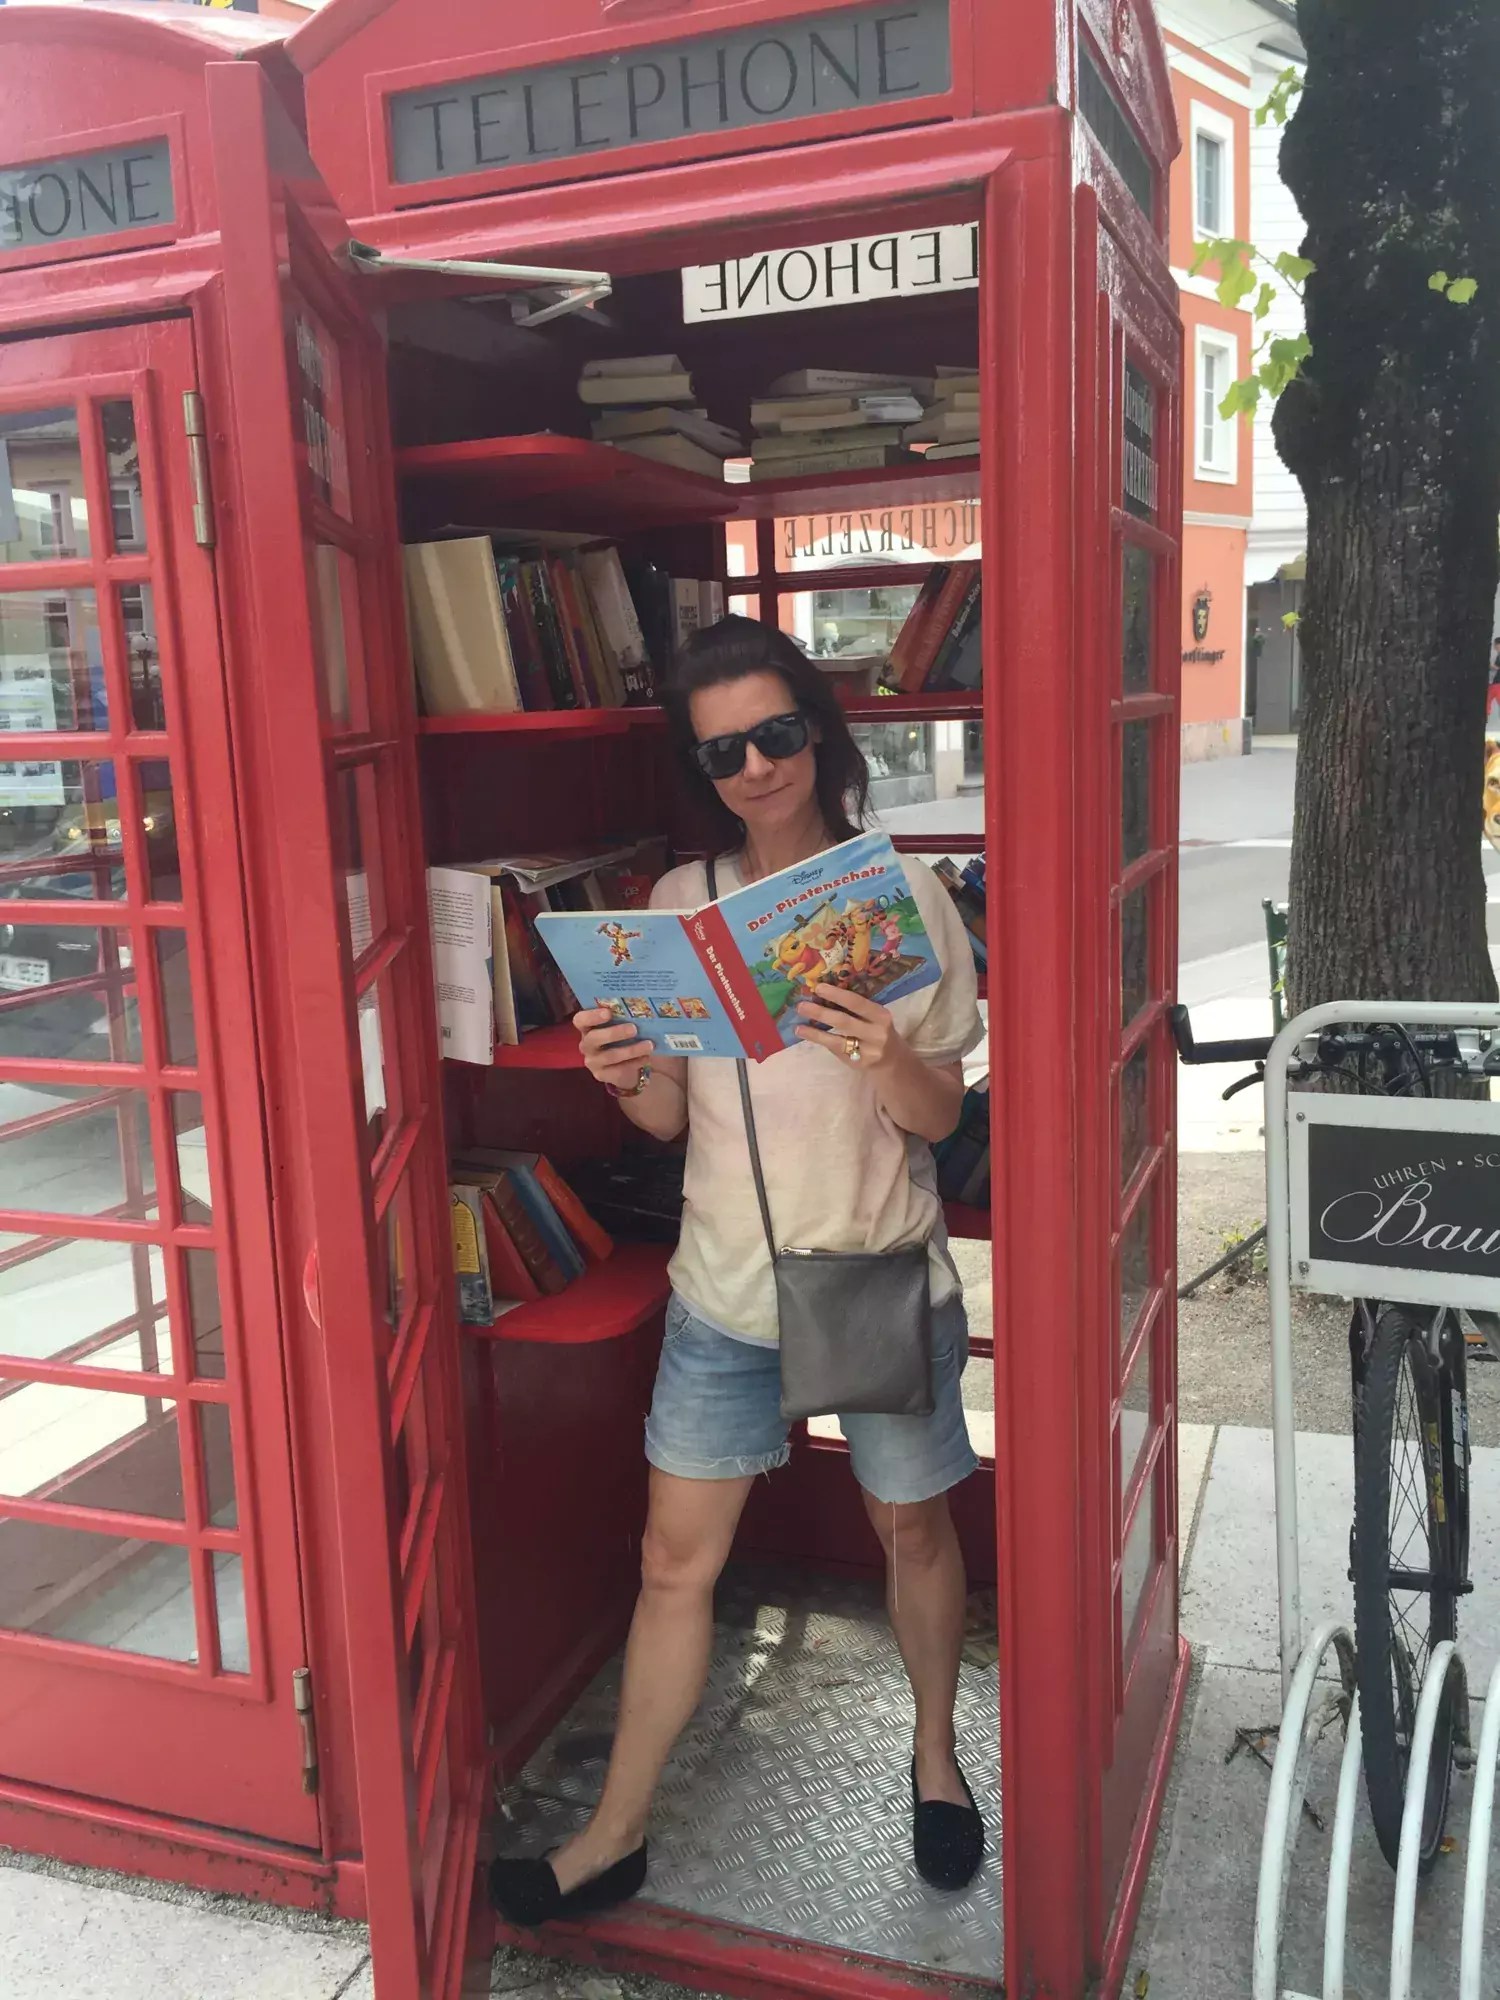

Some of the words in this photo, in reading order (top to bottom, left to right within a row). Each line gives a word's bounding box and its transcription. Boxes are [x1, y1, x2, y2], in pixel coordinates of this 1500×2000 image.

[413, 13, 920, 171] TELEPHONE
[746, 912, 774, 932] Der
[775, 866, 886, 913] Piratenschatz
[787, 867, 824, 885] Disney
[706, 945, 718, 963] Der
[714, 962, 746, 1021] Piratenschatz
[1373, 1158, 1447, 1189] UHREN
